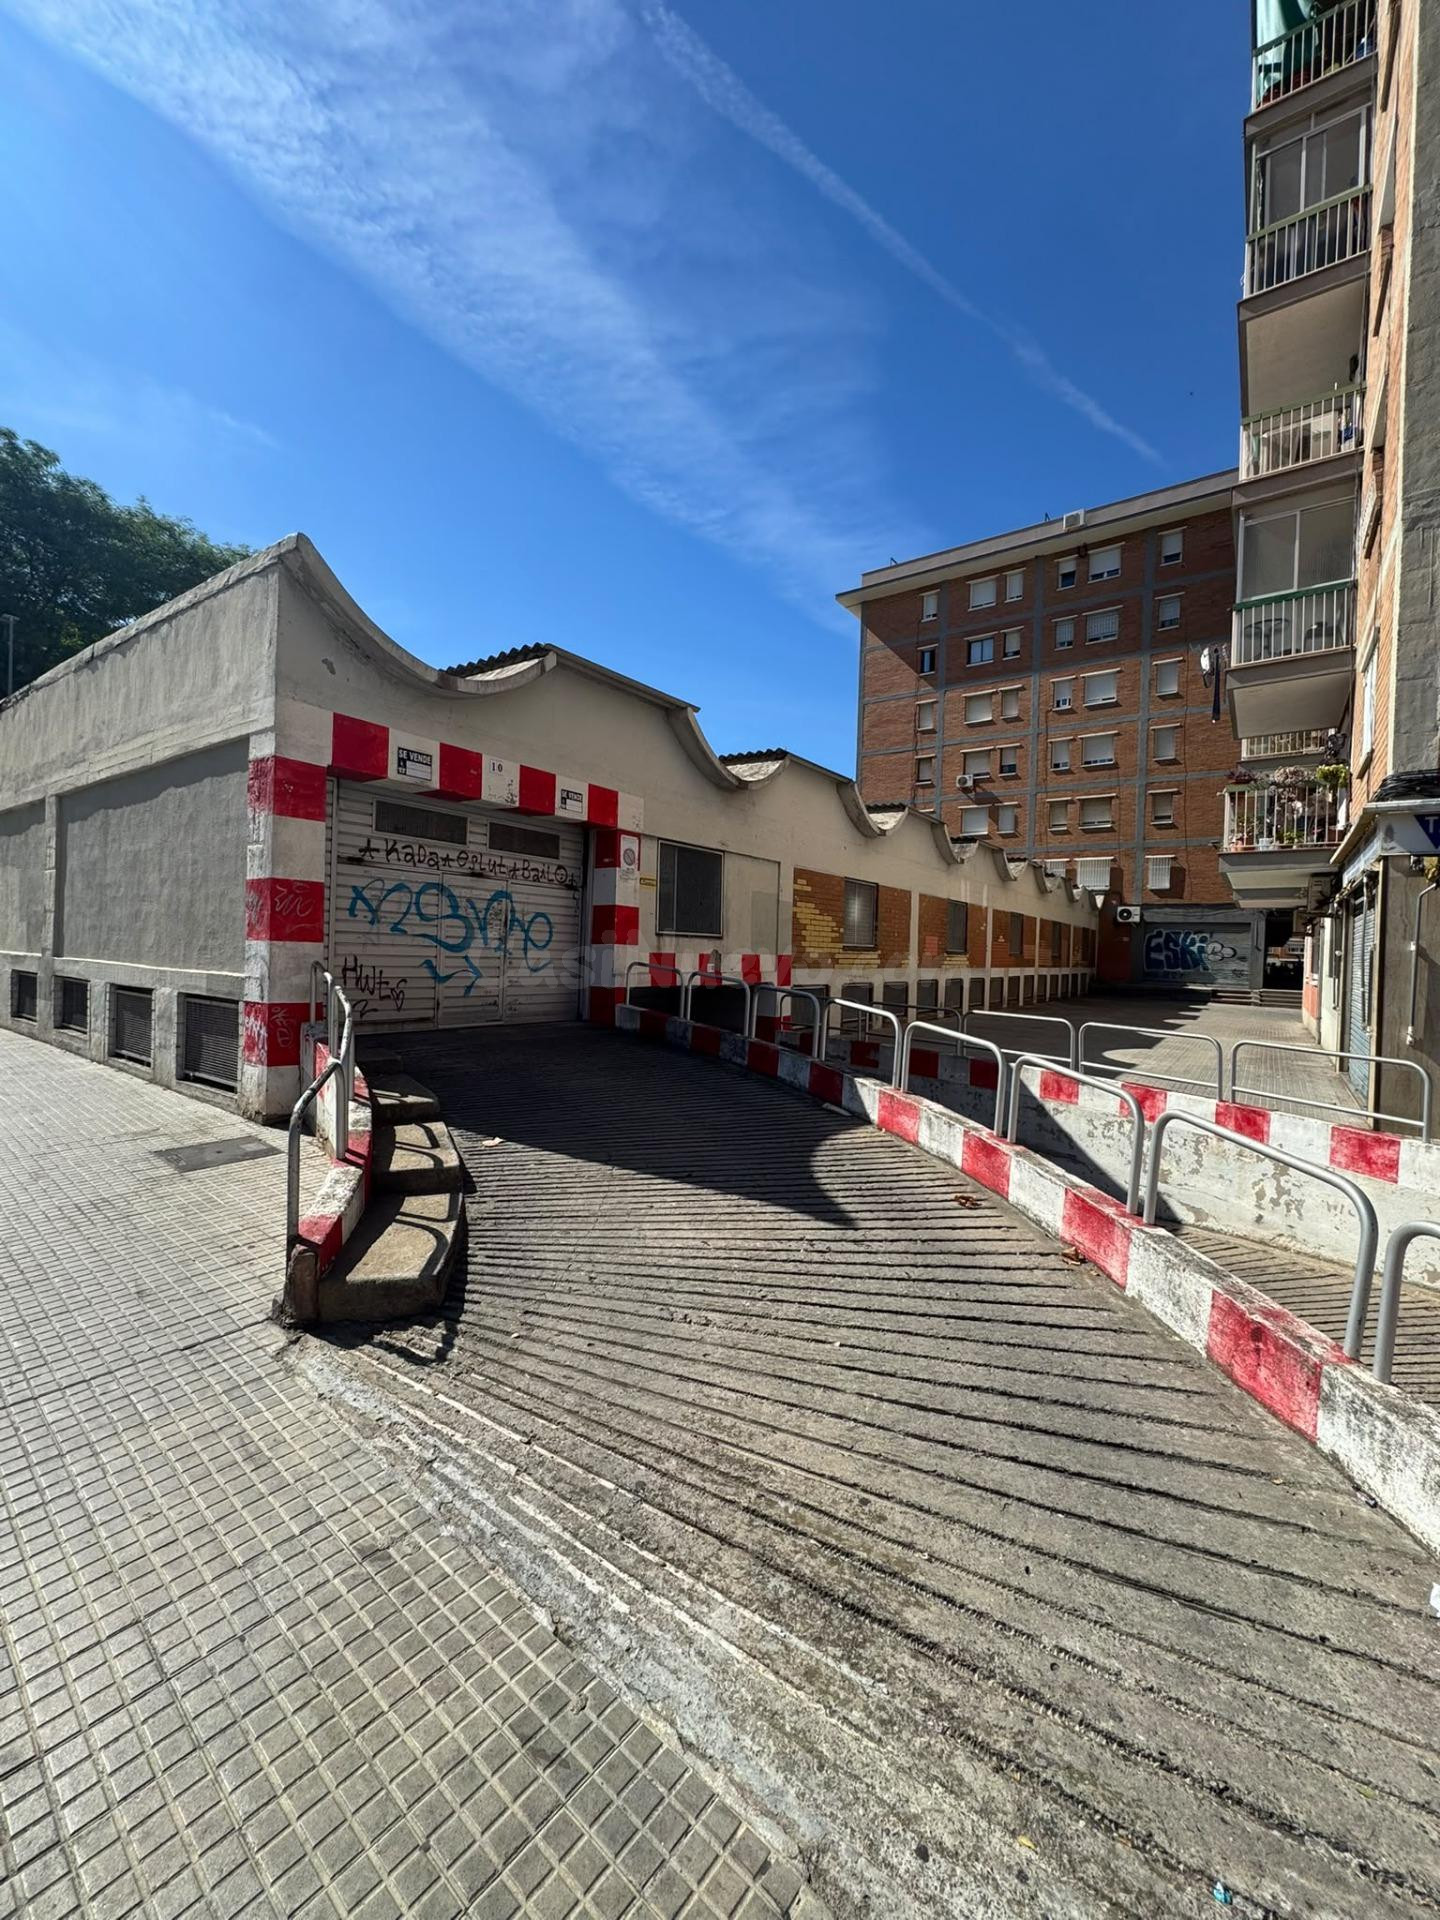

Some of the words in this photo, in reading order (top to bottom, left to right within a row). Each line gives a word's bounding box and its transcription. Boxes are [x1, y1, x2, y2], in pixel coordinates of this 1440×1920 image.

[398, 749, 408, 760] SE
[409, 751, 432, 765] VENDE
[491, 762, 503, 773] 10
